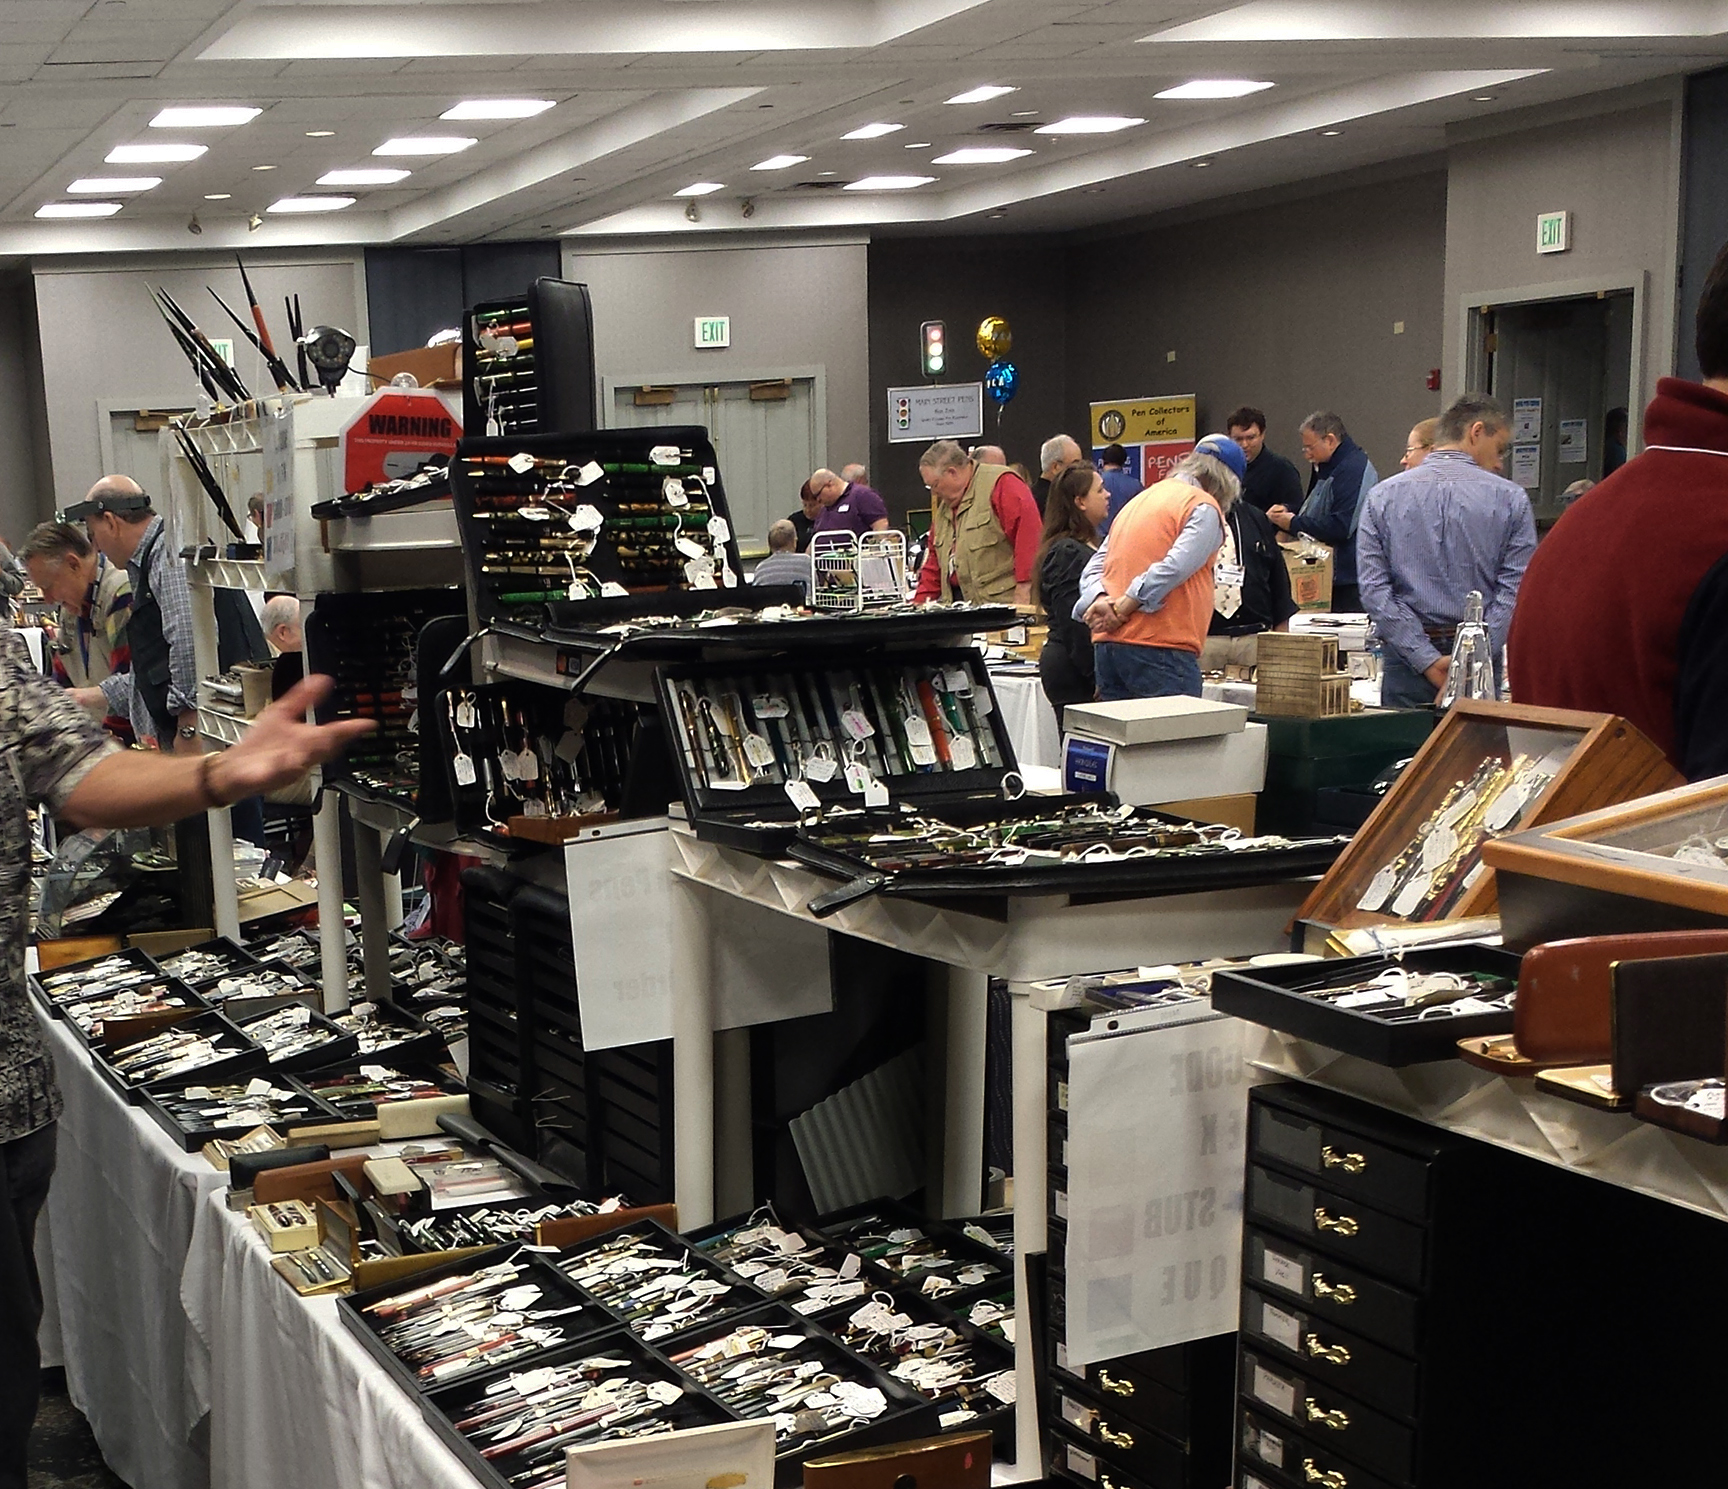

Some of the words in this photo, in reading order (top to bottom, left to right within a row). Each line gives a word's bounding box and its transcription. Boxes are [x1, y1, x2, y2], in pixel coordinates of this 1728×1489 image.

[1542, 218, 1562, 246] EXIT
[702, 321, 725, 341] EXIT
[1131, 409, 1146, 417] Pen
[1149, 405, 1190, 416] Collectors
[368, 414, 452, 439] WARNING
[1145, 428, 1178, 436] America
